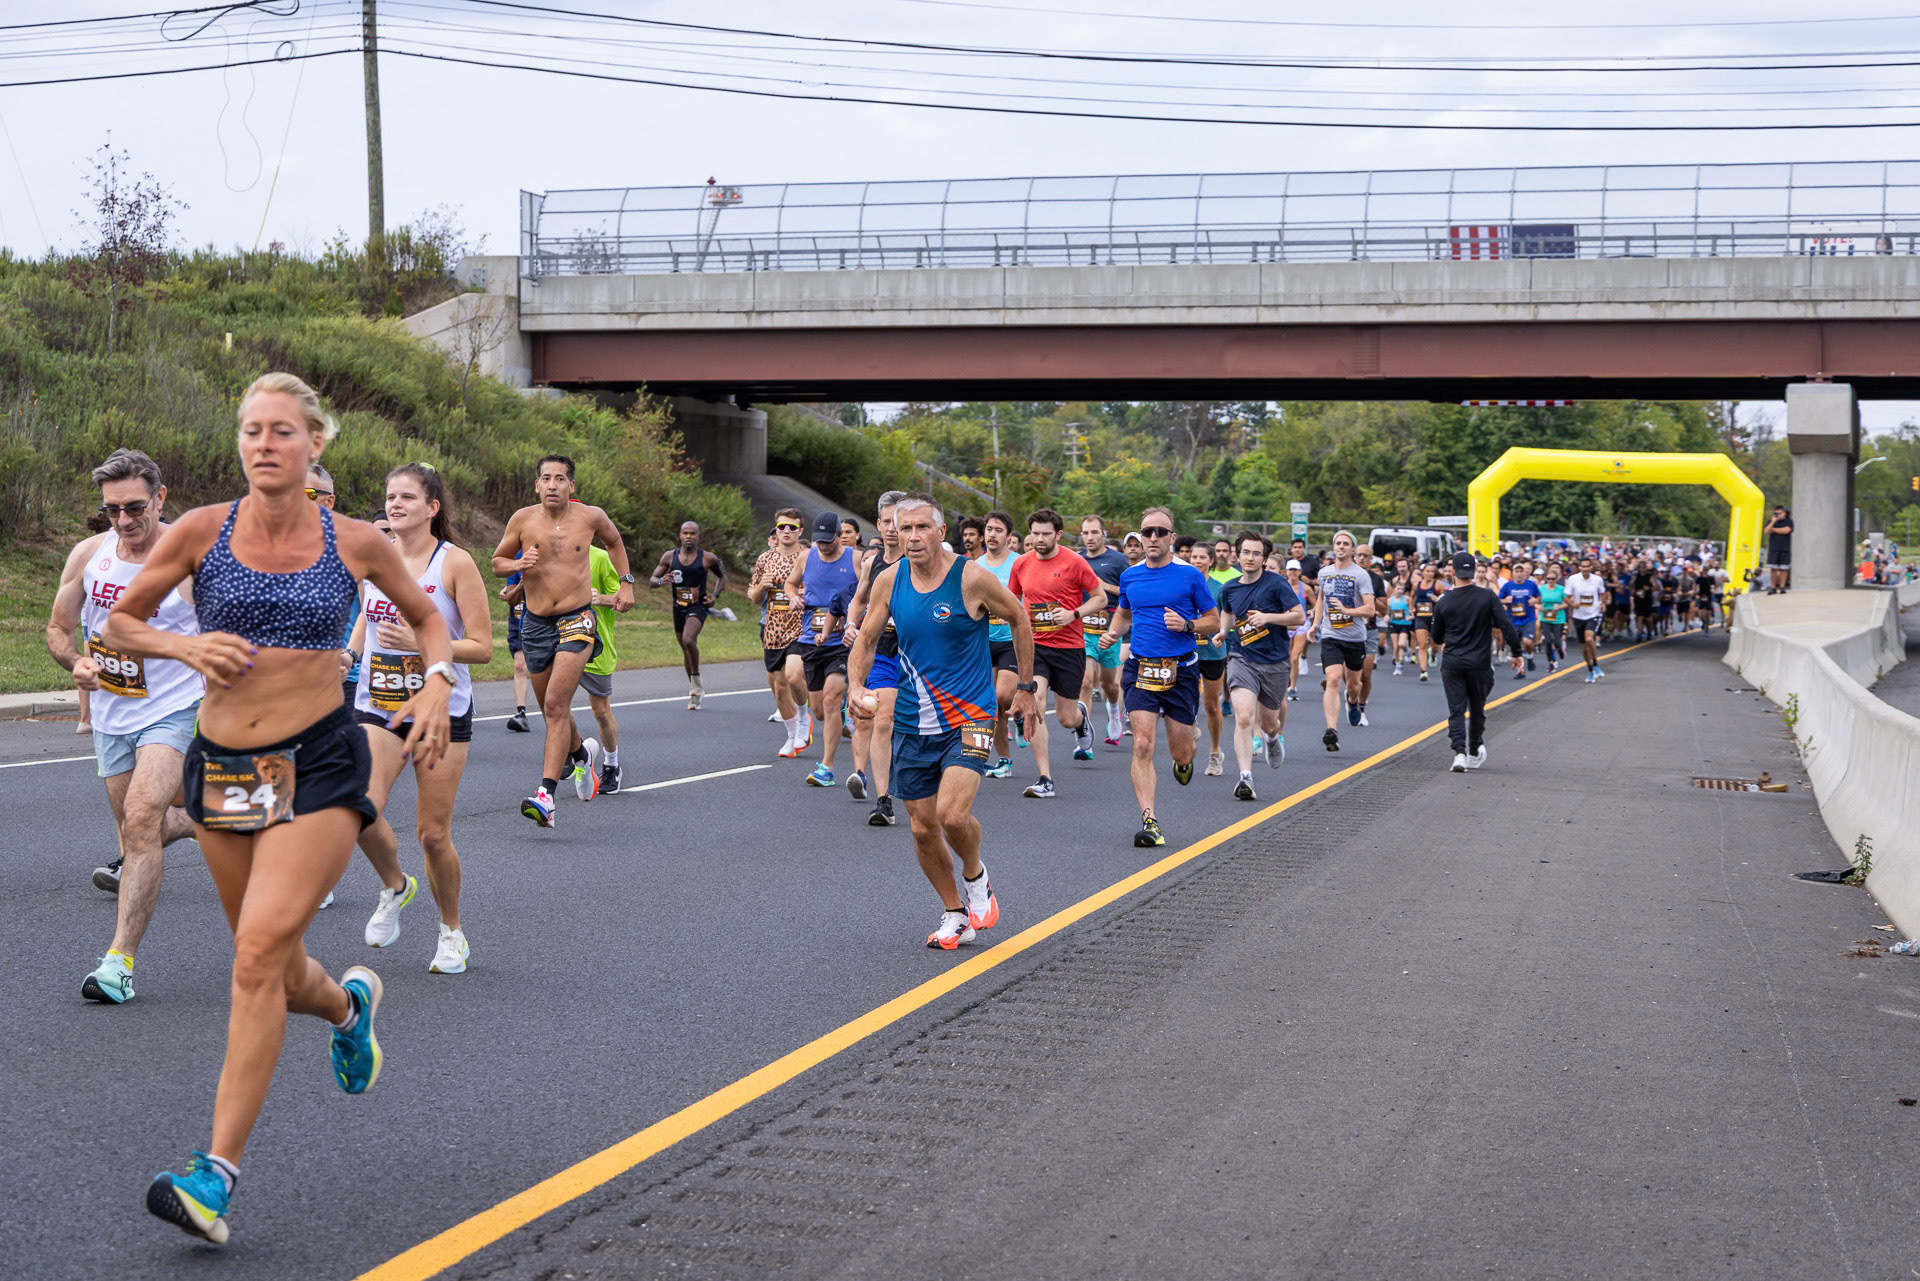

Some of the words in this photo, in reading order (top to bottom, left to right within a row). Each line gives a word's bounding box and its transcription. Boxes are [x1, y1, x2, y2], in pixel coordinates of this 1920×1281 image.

[91, 597, 115, 609] TRAC
[1082, 615, 1107, 625] 230
[93, 652, 138, 677] 699
[1143, 667, 1171, 679] 219
[373, 671, 423, 690] 236
[205, 762, 223, 770] THE
[205, 774, 238, 782] CHASE
[239, 773, 255, 781] 5K
[223, 783, 277, 811] 24
